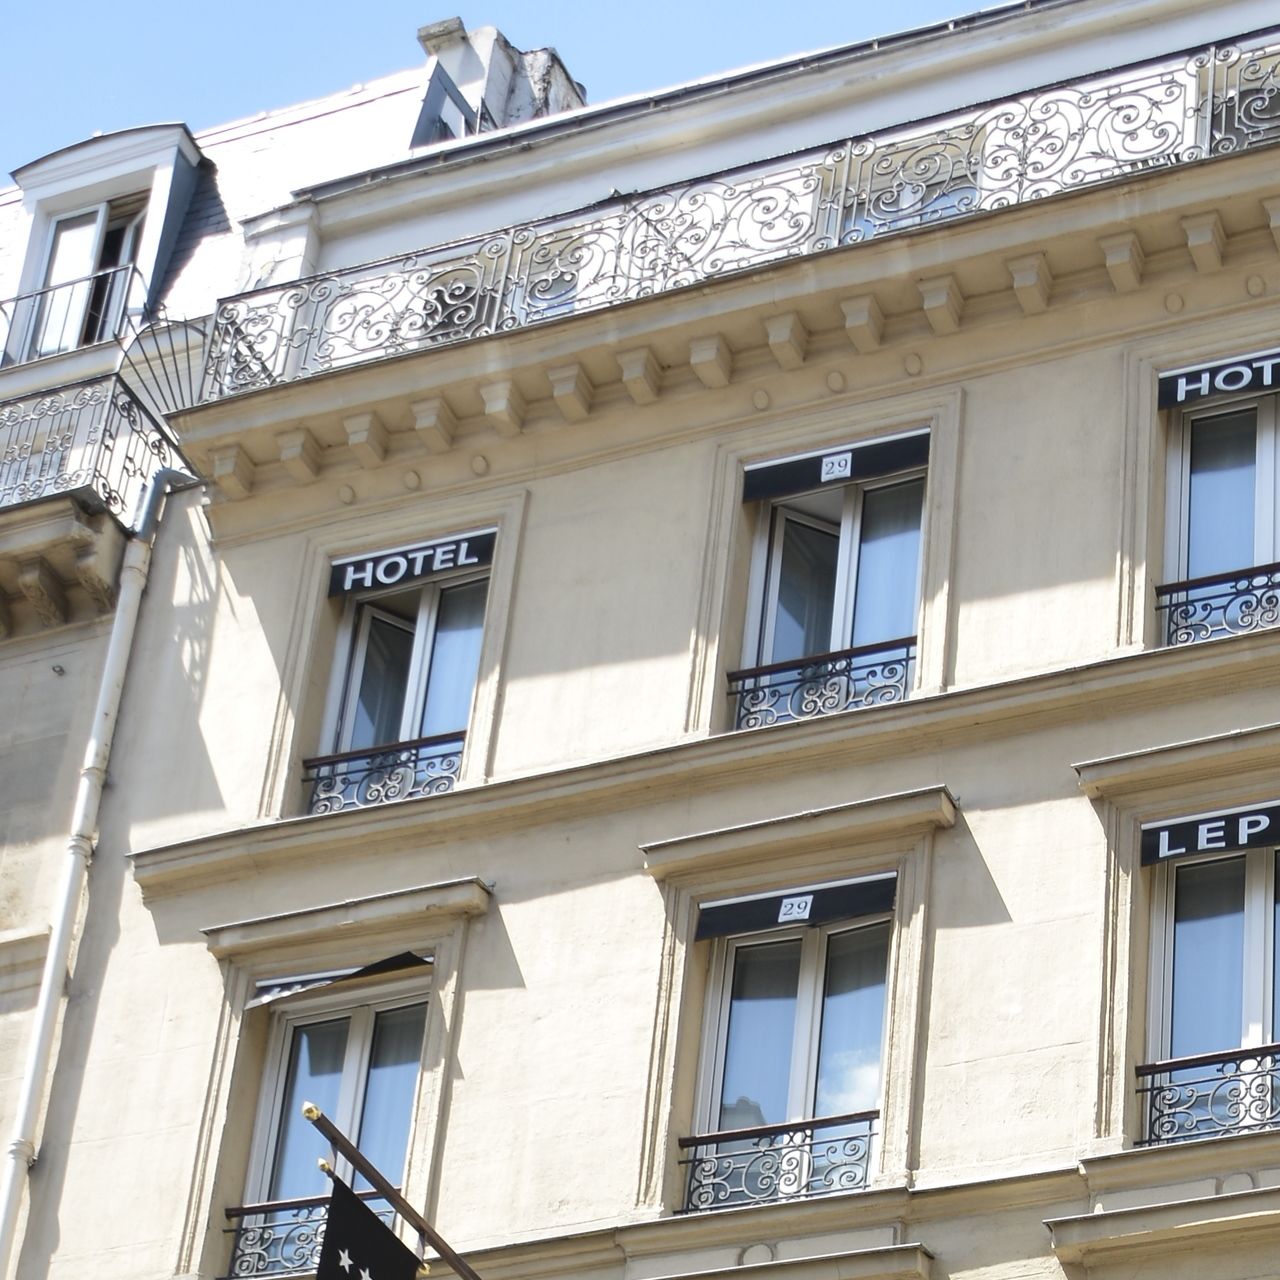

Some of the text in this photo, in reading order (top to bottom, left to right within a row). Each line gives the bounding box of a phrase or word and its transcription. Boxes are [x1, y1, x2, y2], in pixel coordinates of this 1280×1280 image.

[825, 458, 850, 476] 29
[343, 543, 478, 591] HOTEL
[783, 899, 810, 919] 29
